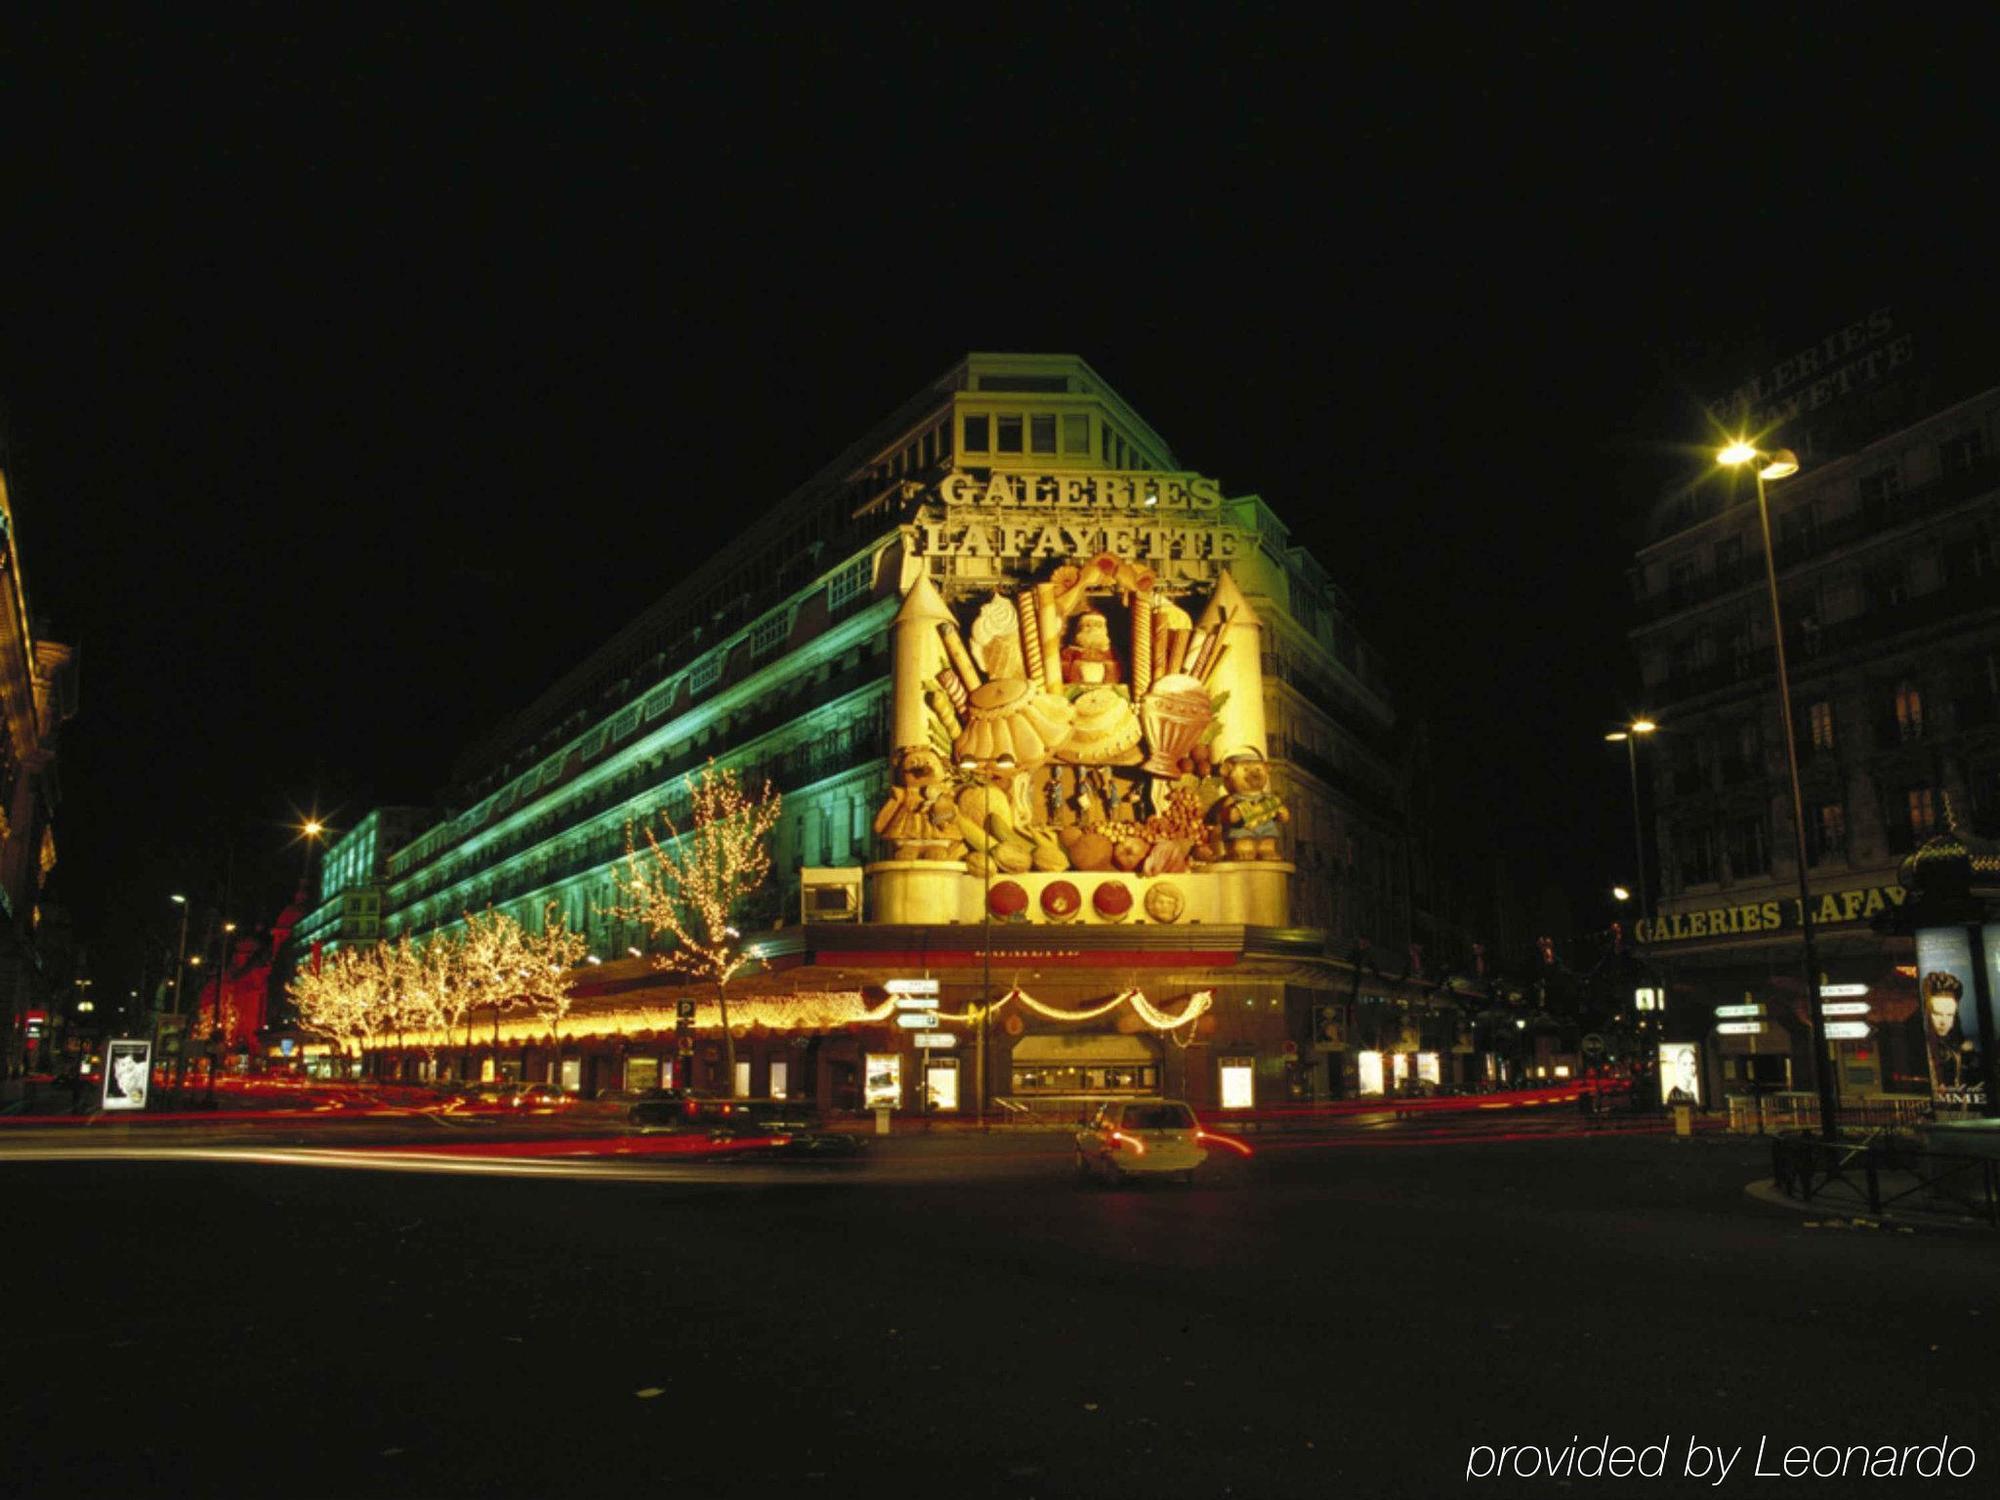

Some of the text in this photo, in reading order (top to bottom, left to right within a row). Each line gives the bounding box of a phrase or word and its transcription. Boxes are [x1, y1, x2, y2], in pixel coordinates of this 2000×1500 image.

[940, 472, 1221, 511] GALERIES
[922, 523, 1241, 561] LAFAYETTE
[1635, 900, 1782, 943] GALERIES
